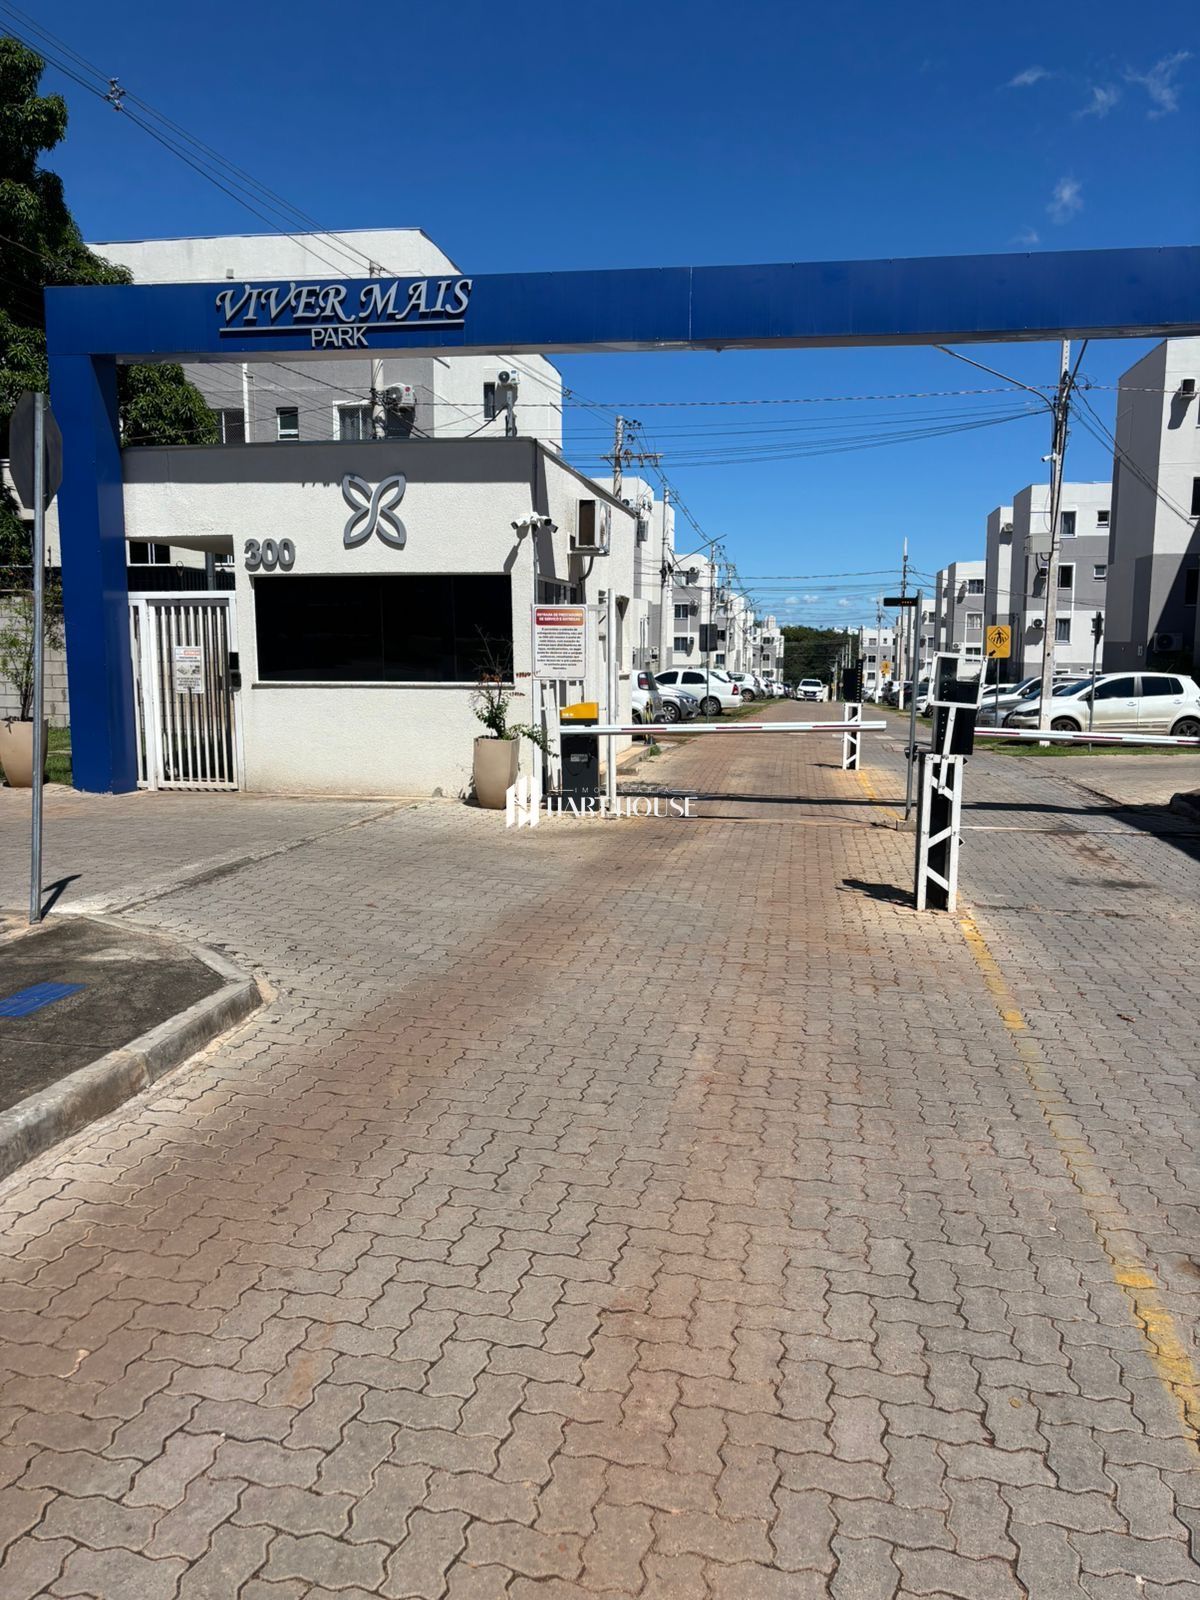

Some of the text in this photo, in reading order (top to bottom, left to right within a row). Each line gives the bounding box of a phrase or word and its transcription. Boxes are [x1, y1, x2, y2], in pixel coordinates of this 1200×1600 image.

[215, 279, 473, 322] VIVER MAIS
[311, 326, 369, 348] PARK
[244, 538, 296, 569] 300
